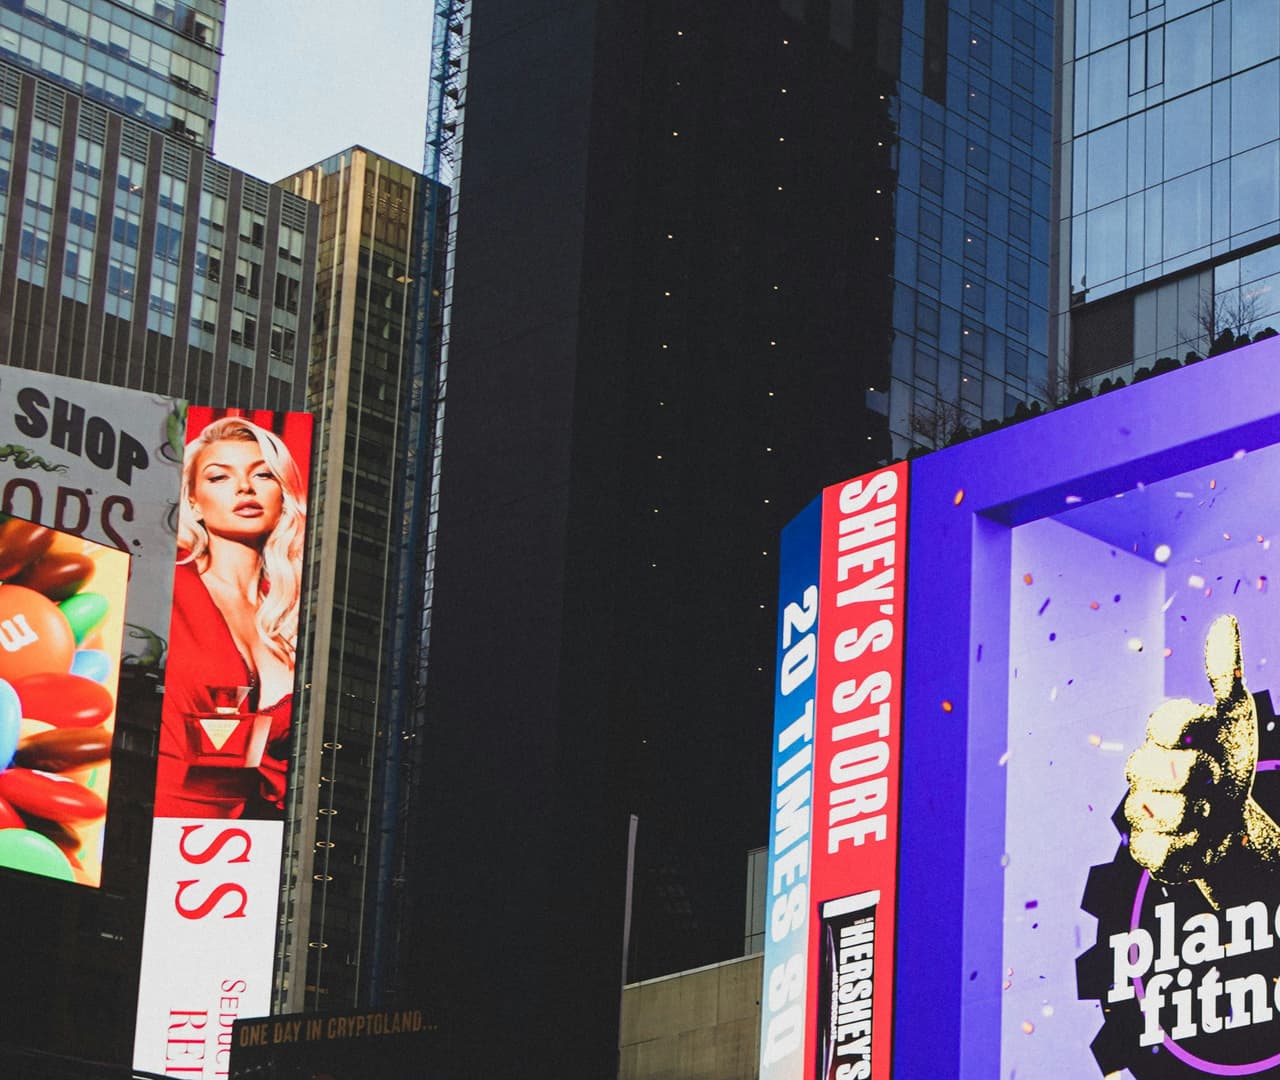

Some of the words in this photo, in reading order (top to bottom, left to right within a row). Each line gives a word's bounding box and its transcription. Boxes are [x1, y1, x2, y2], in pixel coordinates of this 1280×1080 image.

[14, 387, 149, 486] SHOP
[833, 470, 898, 663] SHEY'S
[781, 585, 818, 696] 20
[771, 698, 814, 944] TIMES
[827, 671, 893, 854] STORE
[240, 1023, 268, 1047] ONE
[273, 1020, 302, 1044] DAY
[306, 1018, 322, 1041] IN
